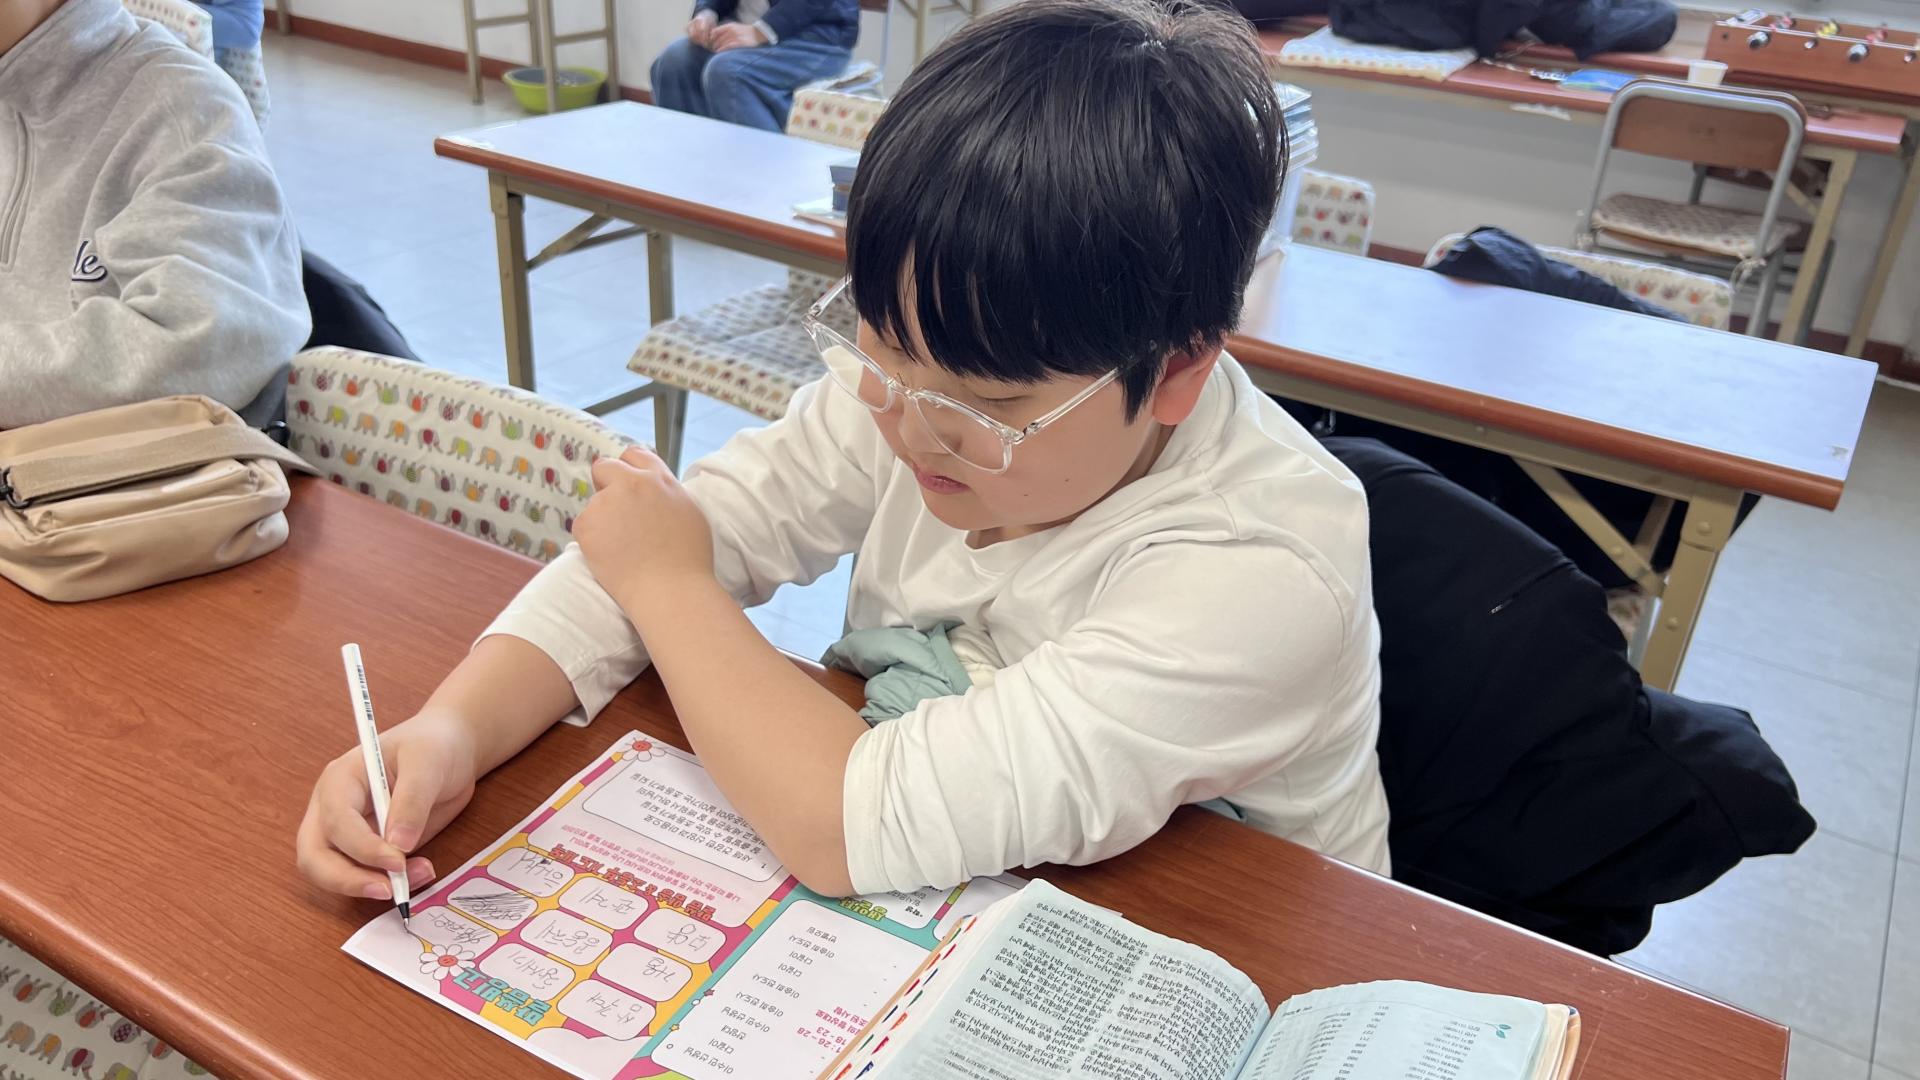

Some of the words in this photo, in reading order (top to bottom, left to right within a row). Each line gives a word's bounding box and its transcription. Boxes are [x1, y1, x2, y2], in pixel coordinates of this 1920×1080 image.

[635, 785, 672, 806] 하나님의
[647, 779, 684, 799] 초등부가
[642, 812, 681, 833] 마음으로
[657, 807, 695, 828] 초등부가
[677, 827, 707, 844] 신앙과
[693, 823, 713, 835] 있는
[711, 830, 724, 839] 수
[548, 842, 580, 867] 제목
[704, 838, 733, 855] 건강한
[573, 854, 606, 876] 기도
[731, 850, 753, 863] 새해
[600, 864, 647, 892] 초등부
[683, 899, 719, 923] 말씀
[786, 934, 812, 948] 전도사
[787, 950, 814, 965] 다같이
[809, 943, 837, 958] 이승희
[776, 962, 804, 977] 다같이
[750, 973, 777, 988] 전도사
[452, 967, 552, 1027] 말씀빙고
[733, 991, 761, 1006] 전도사
[773, 983, 802, 998] 이승희
[719, 1005, 748, 1022] 선생님
[756, 1001, 786, 1017] 이승희
[832, 1006, 851, 1019] 사람
[719, 1024, 748, 1040] 찬양대
[743, 1016, 773, 1033] 이수민
[815, 1026, 830, 1037] 23
[681, 1045, 710, 1062] 선생님
[706, 1037, 736, 1054] 다같이
[706, 1056, 736, 1074] 이수민
